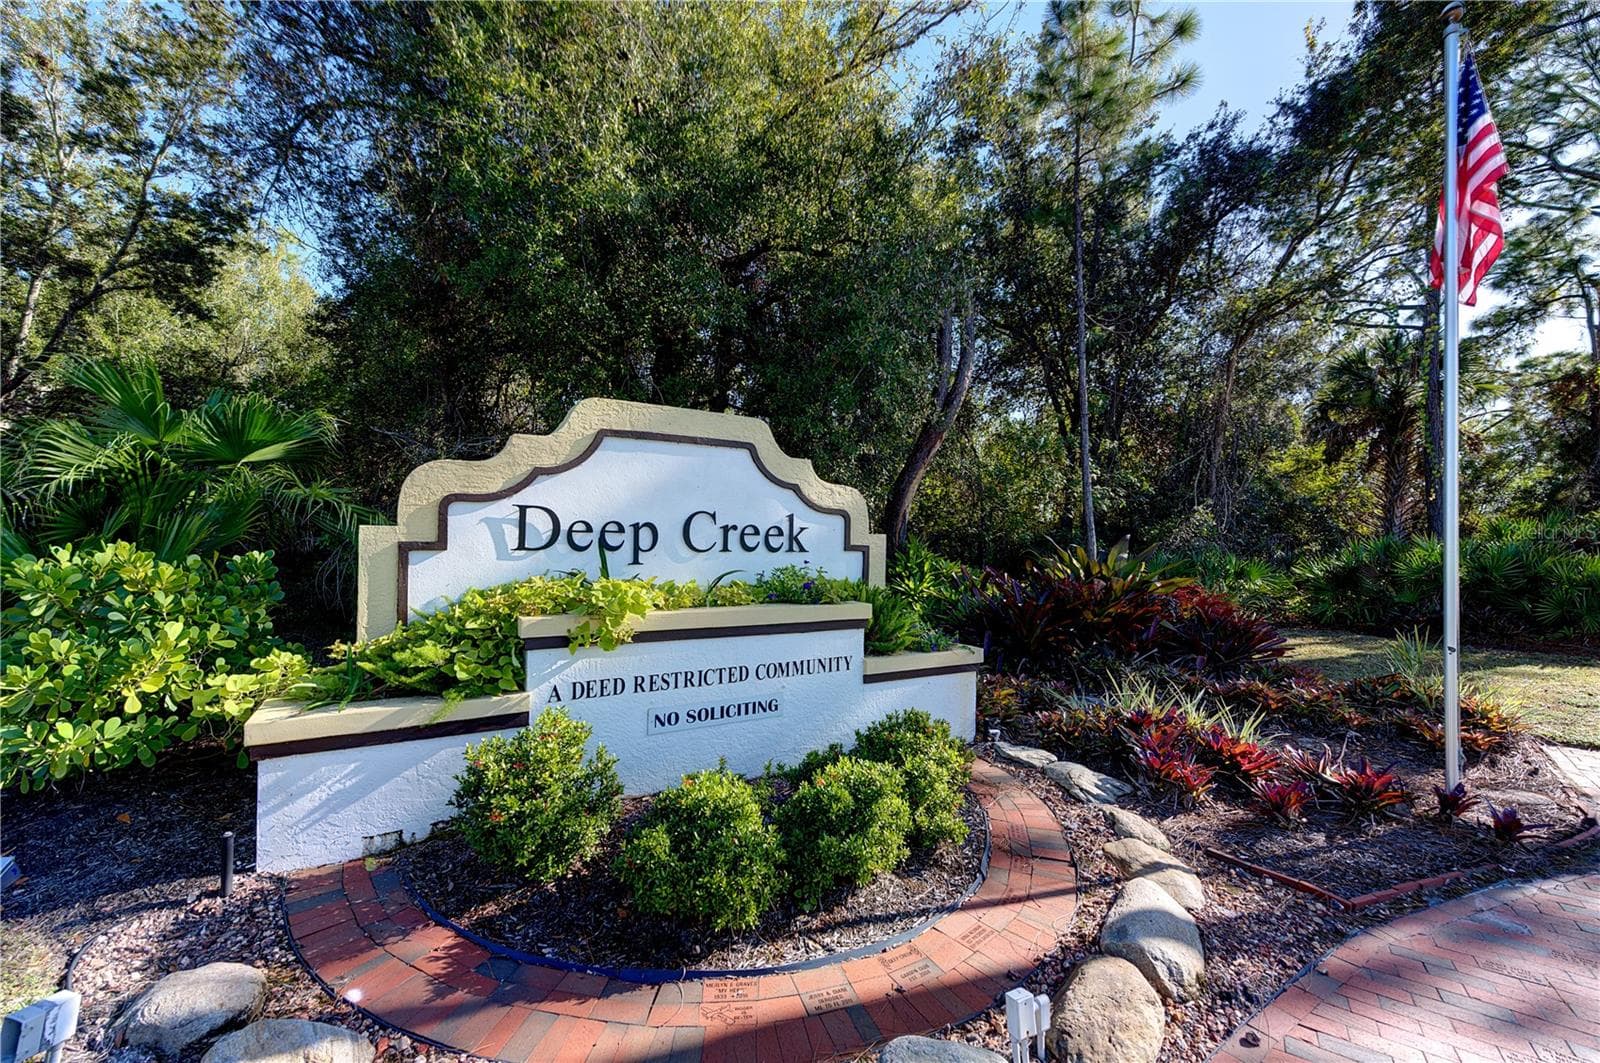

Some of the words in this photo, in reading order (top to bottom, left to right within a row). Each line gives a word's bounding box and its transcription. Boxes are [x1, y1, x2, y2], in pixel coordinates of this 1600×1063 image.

[511, 503, 659, 565] Deep
[682, 510, 810, 553] Creek
[547, 684, 562, 703] A
[571, 677, 626, 701] DEED
[633, 665, 750, 694] RESTRICTED
[755, 655, 853, 681] COMMUNITY
[654, 711, 680, 729] NO
[686, 698, 779, 724] SOLICITING
